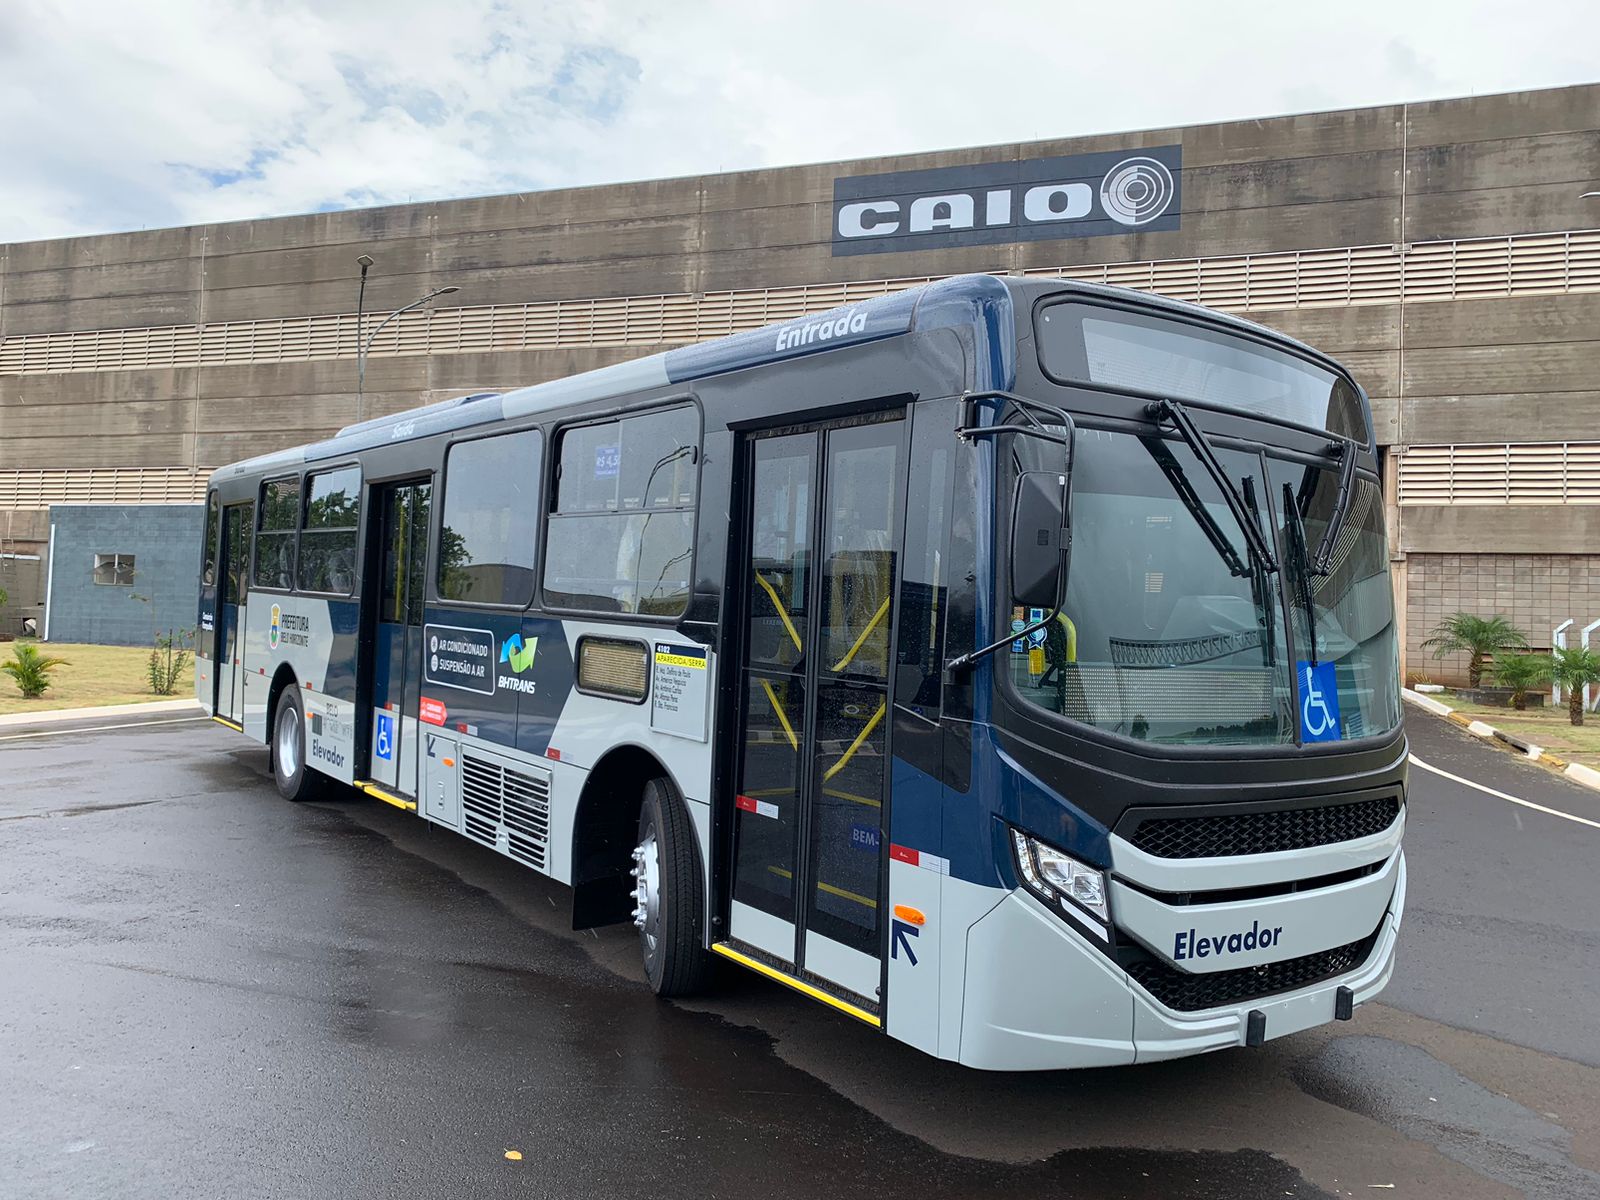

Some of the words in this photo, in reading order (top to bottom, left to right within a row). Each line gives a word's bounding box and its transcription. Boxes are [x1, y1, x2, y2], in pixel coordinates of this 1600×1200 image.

[838, 183, 1093, 238] CAIO
[775, 308, 868, 352] Entrada
[281, 613, 310, 632] PREFEITURA
[439, 640, 447, 653] AR
[447, 640, 488, 657] CONDICIONADO
[439, 659, 470, 675] SUSPENSÃO
[471, 665, 476, 676] A
[476, 666, 485, 678] AR
[498, 676, 536, 694] BHTRANS
[312, 738, 345, 768] Elevador
[1174, 920, 1282, 960] Elevador
